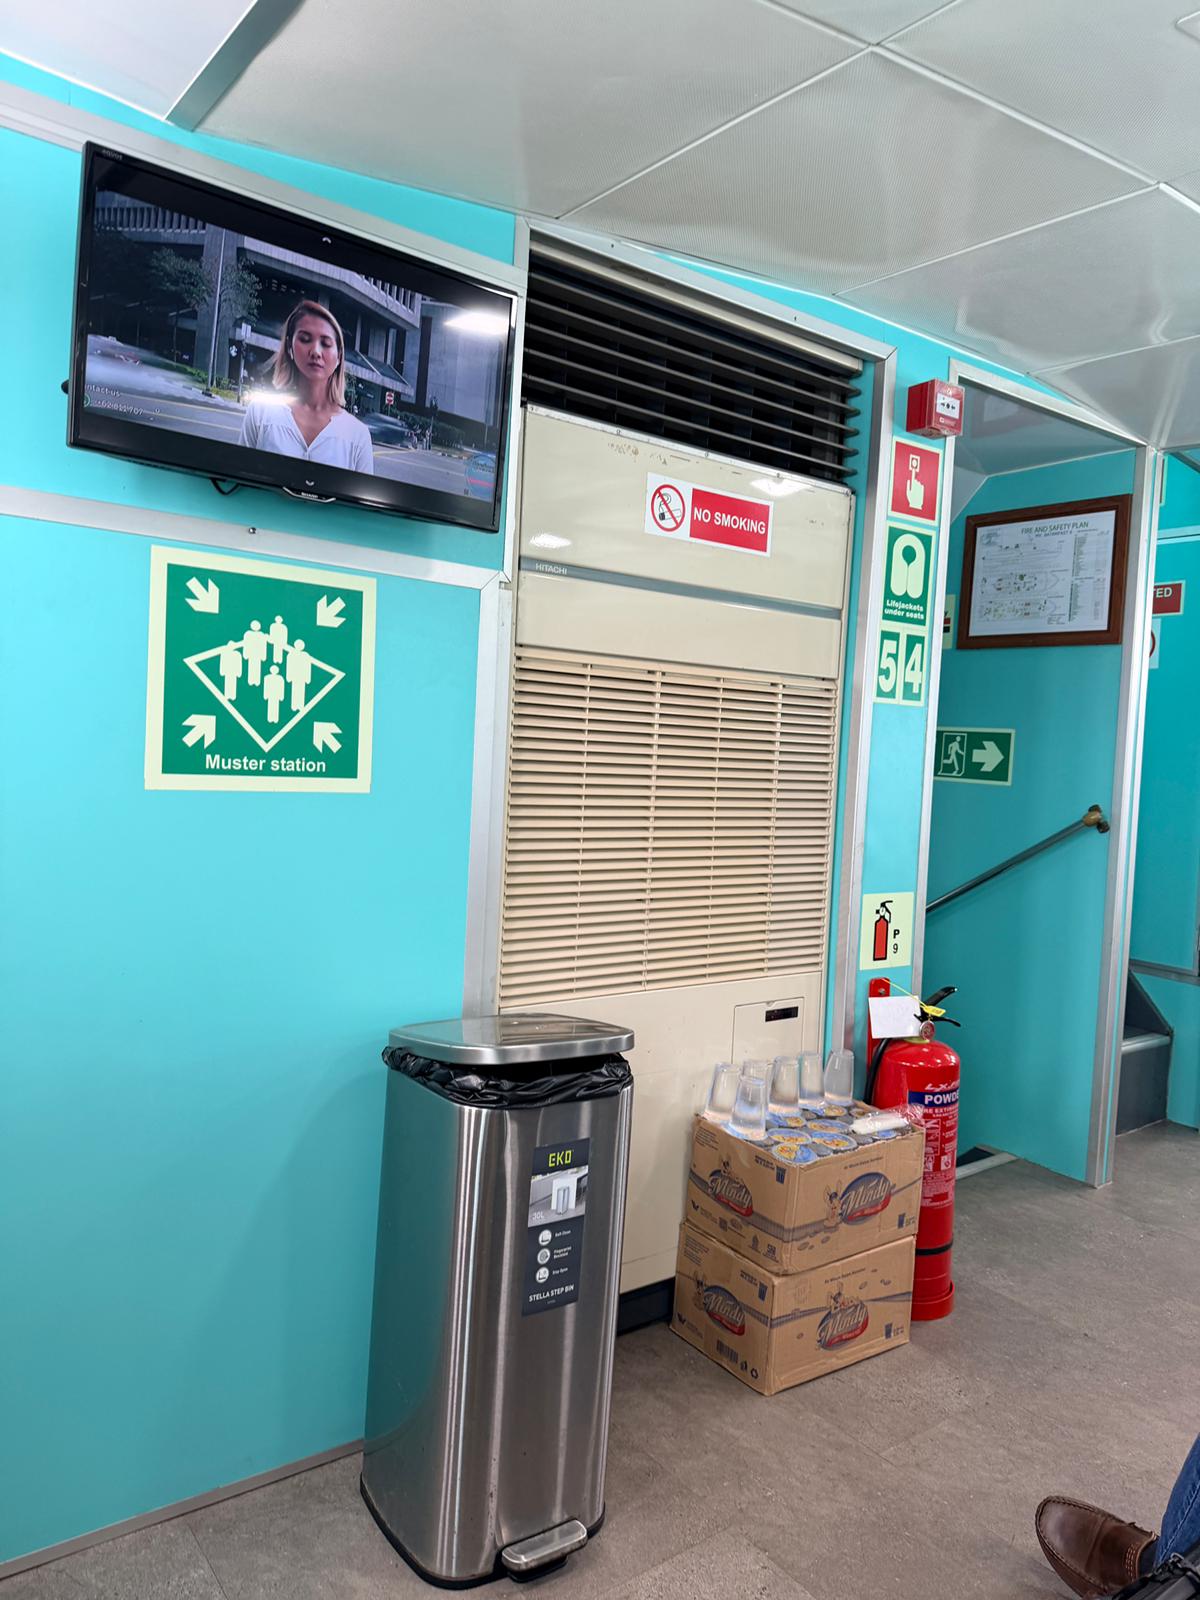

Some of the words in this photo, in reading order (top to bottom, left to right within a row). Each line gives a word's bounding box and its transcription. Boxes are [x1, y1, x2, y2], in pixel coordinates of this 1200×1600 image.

[693, 506, 711, 523] NO
[714, 511, 766, 535] SMOKING
[1021, 527, 1032, 535] FIRE
[1049, 522, 1071, 532] SAFETY
[1072, 521, 1089, 529] PLAN
[535, 562, 568, 575] HITACHI
[886, 599, 924, 612] Lifejackets
[884, 608, 904, 616] under
[905, 611, 924, 620] seats
[205, 754, 266, 771] Muster
[270, 757, 326, 773] station
[893, 929, 900, 939] P
[892, 943, 899, 954] 9
[548, 1149, 572, 1168] EKO
[528, 1291, 550, 1303] STELLA
[550, 1286, 564, 1297] STEP
[564, 1284, 575, 1293] BIN
